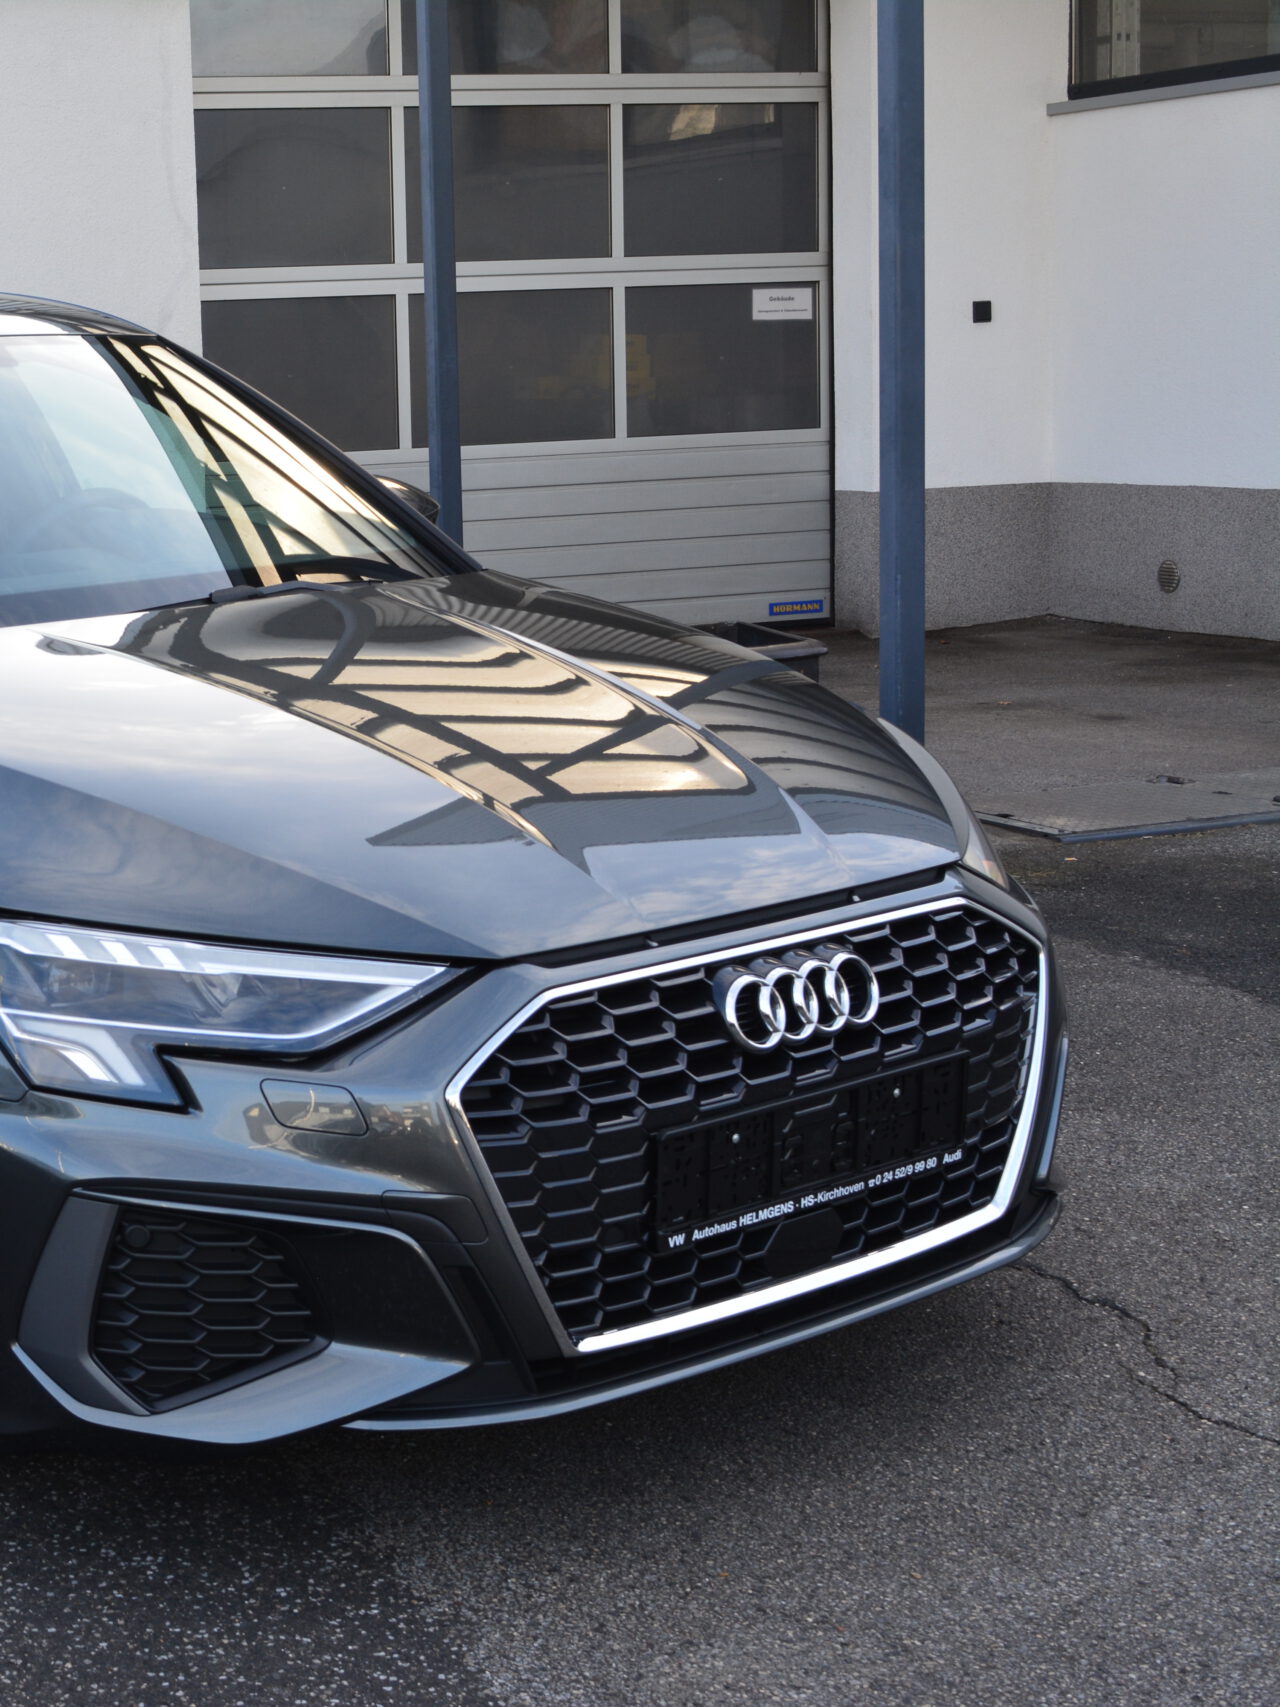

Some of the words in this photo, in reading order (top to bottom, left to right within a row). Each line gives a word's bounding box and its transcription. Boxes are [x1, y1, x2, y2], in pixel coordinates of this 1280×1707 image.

[668, 1233, 685, 1248] VW
[692, 1220, 737, 1241] Autohaus
[739, 1201, 794, 1227] HELMGENS
[801, 1181, 865, 1208] HS-Kirchhoven
[882, 1170, 893, 1183] 24
[914, 1160, 925, 1173] 99
[942, 1149, 962, 1164] Audi
